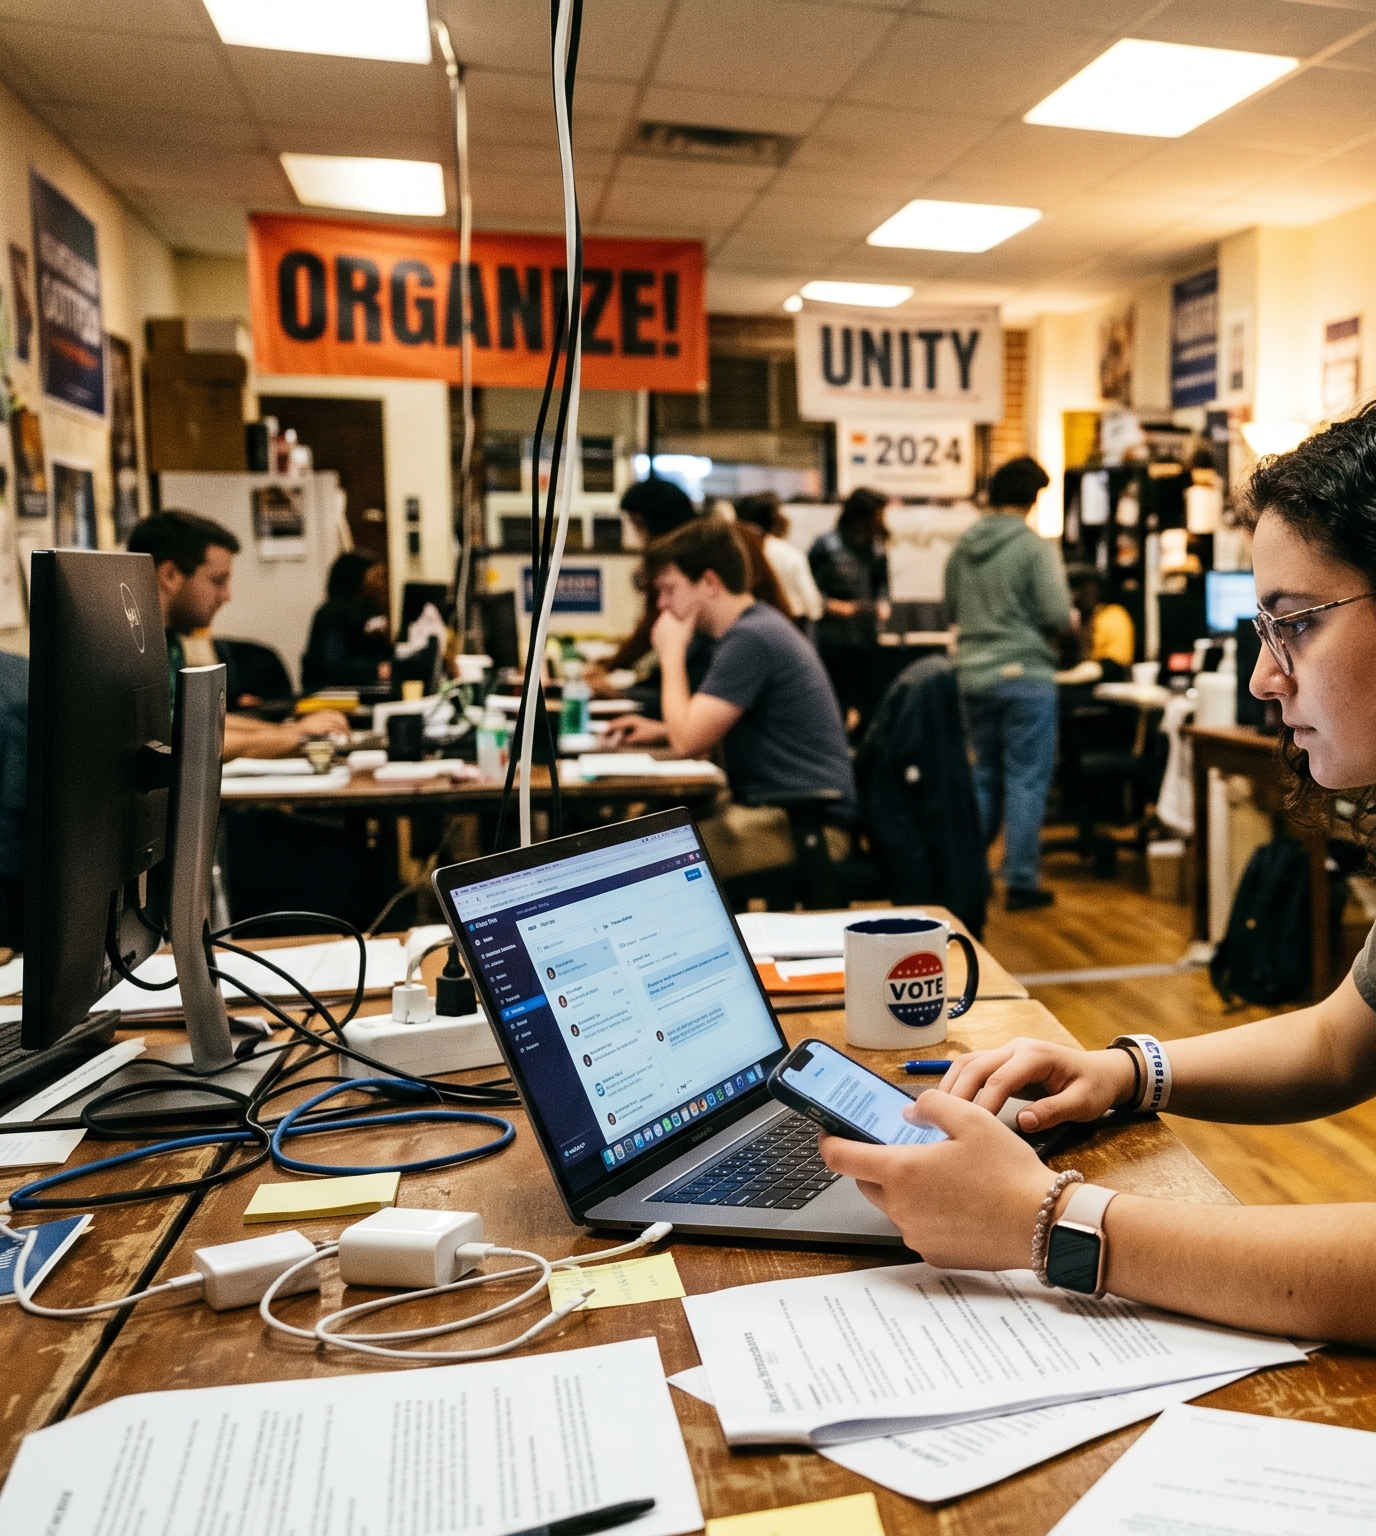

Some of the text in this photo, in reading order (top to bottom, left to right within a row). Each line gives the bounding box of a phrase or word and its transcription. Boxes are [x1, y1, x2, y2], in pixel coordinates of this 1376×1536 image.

[277, 251, 682, 359] ORGANIZE!
[821, 324, 981, 391] UNITY
[875, 433, 963, 467] 2024
[888, 975, 944, 1001] VOTE
